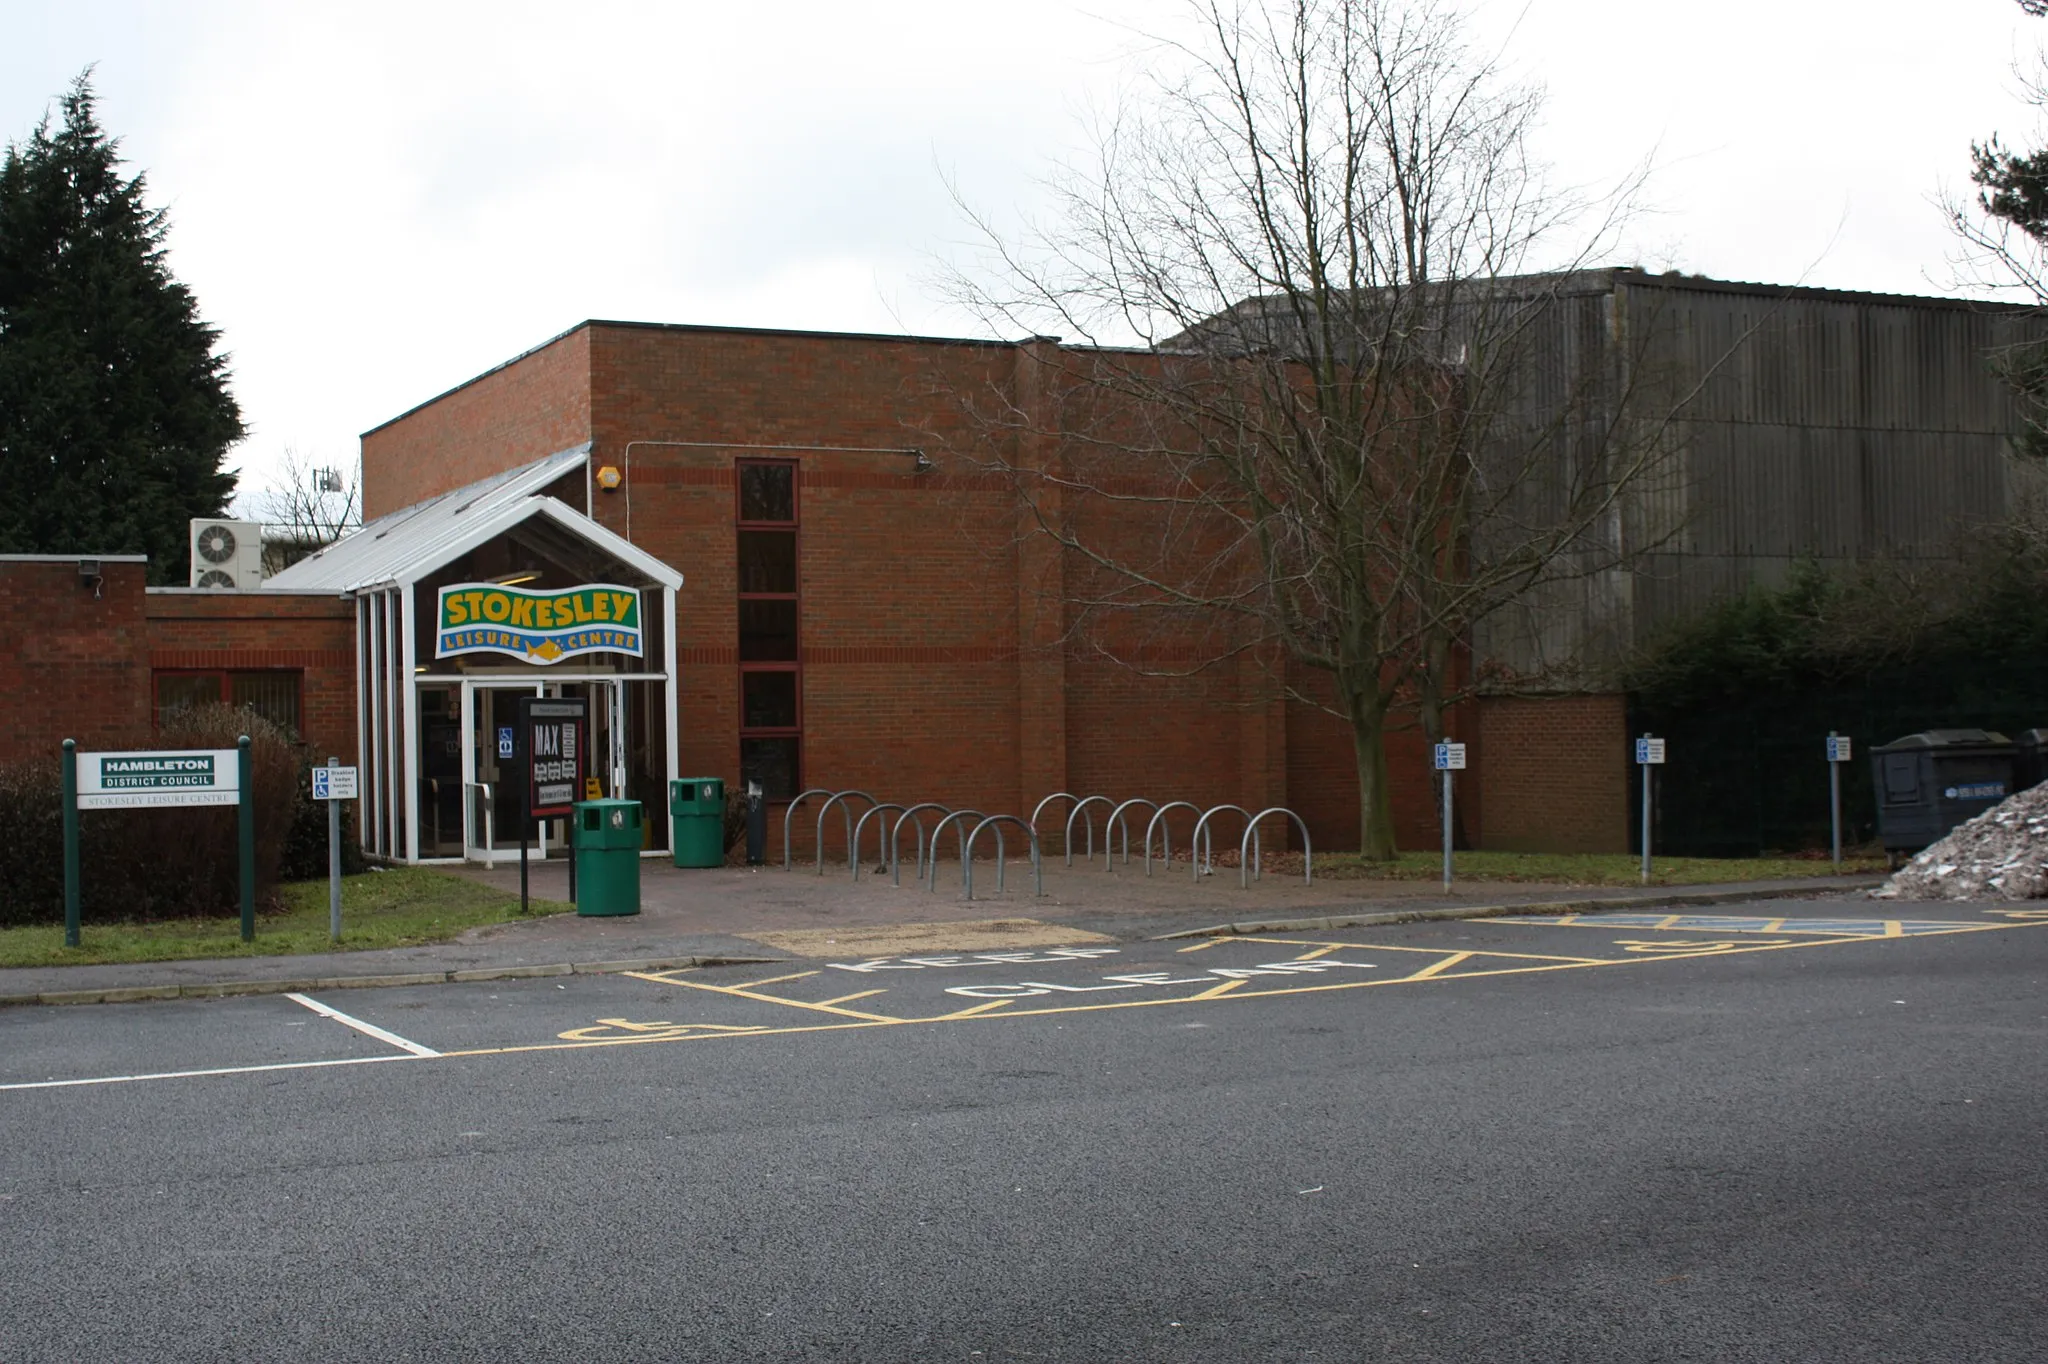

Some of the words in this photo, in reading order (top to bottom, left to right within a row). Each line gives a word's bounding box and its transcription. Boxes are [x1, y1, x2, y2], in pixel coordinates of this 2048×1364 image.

[446, 592, 633, 627] STOKESLEY
[445, 632, 520, 649] LEISURE
[568, 632, 635, 648] CENTRE
[535, 724, 558, 755] MAX
[107, 760, 208, 772] HAMBLETON
[107, 777, 156, 787] DISTRICT
[161, 776, 209, 785] COUNCIL
[317, 770, 327, 783] P
[89, 796, 143, 806] STOKESLEY
[147, 795, 187, 805] LEISURE
[190, 794, 229, 803] CENTRE
[826, 948, 1121, 972] KEEP
[944, 960, 1378, 998] CLEAR
